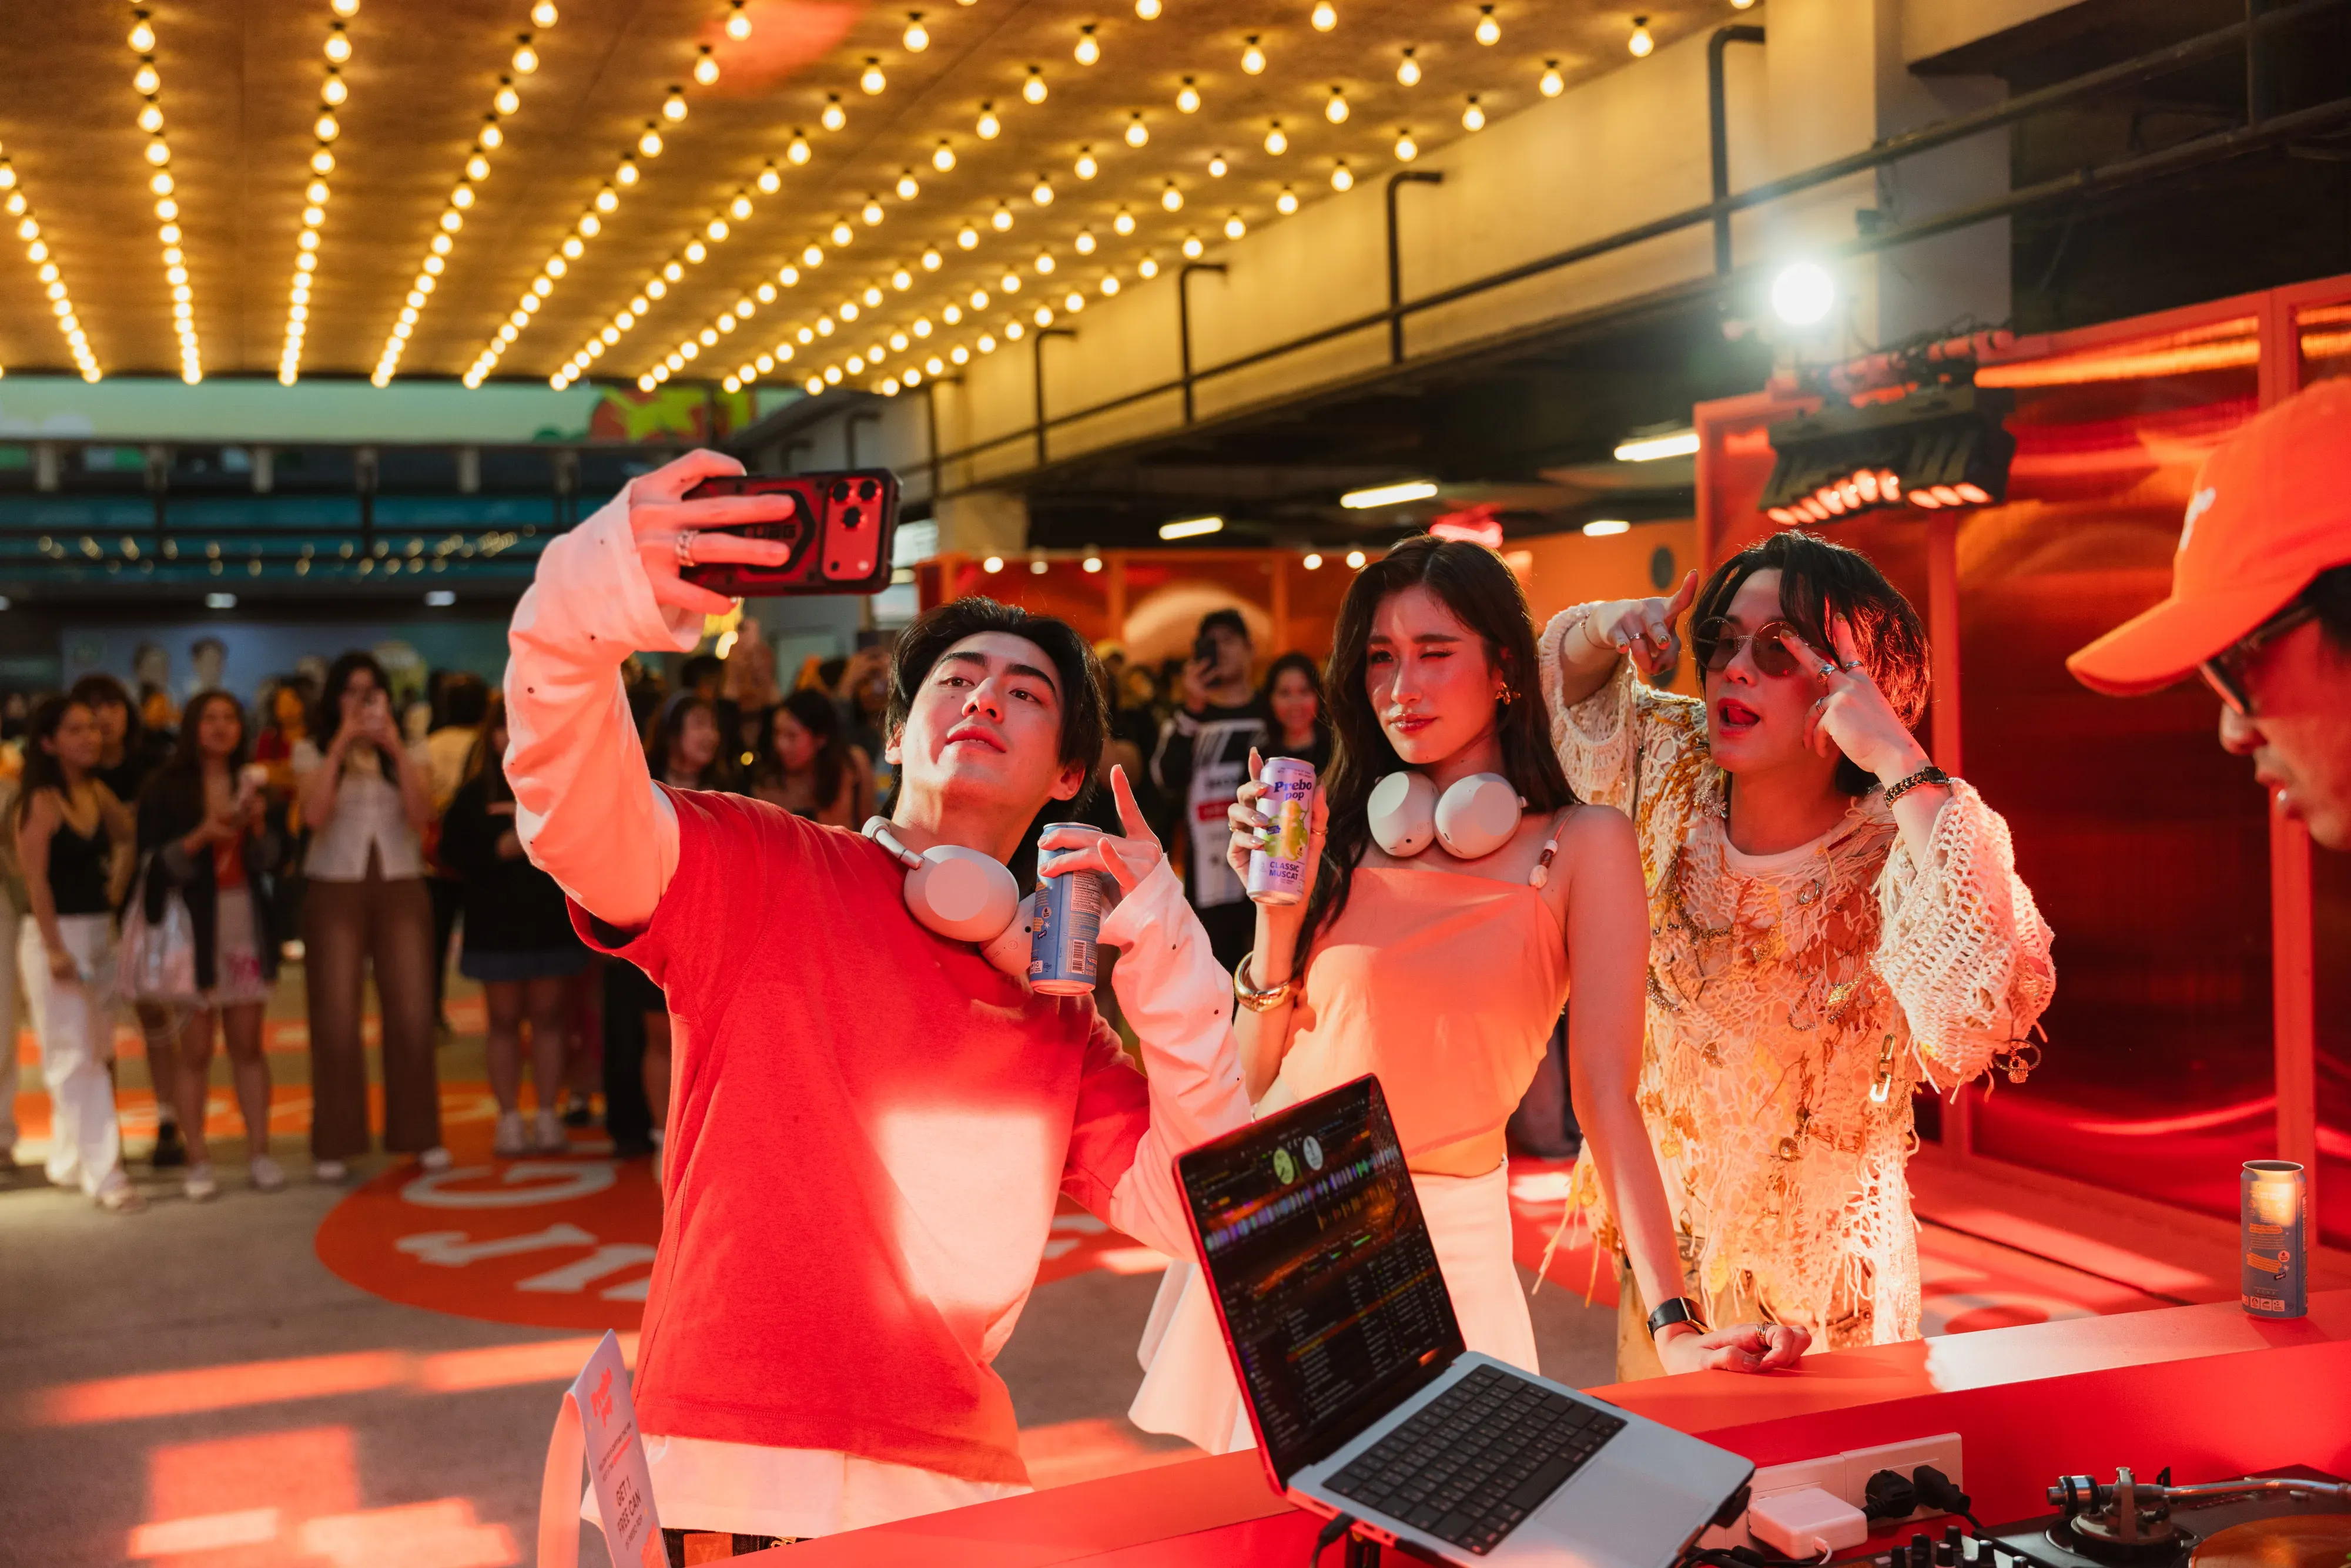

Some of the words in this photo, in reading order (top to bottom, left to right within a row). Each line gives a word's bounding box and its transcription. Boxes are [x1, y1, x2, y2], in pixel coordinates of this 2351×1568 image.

[1273, 779, 1312, 793] Prebo
[1285, 792, 1304, 801] pop
[1270, 861, 1300, 872] CLASSIC
[1269, 869, 1298, 880] MUSCAT
[616, 1479, 627, 1507] GET
[617, 1507, 630, 1539] FREE
[629, 1488, 642, 1516] CAN
